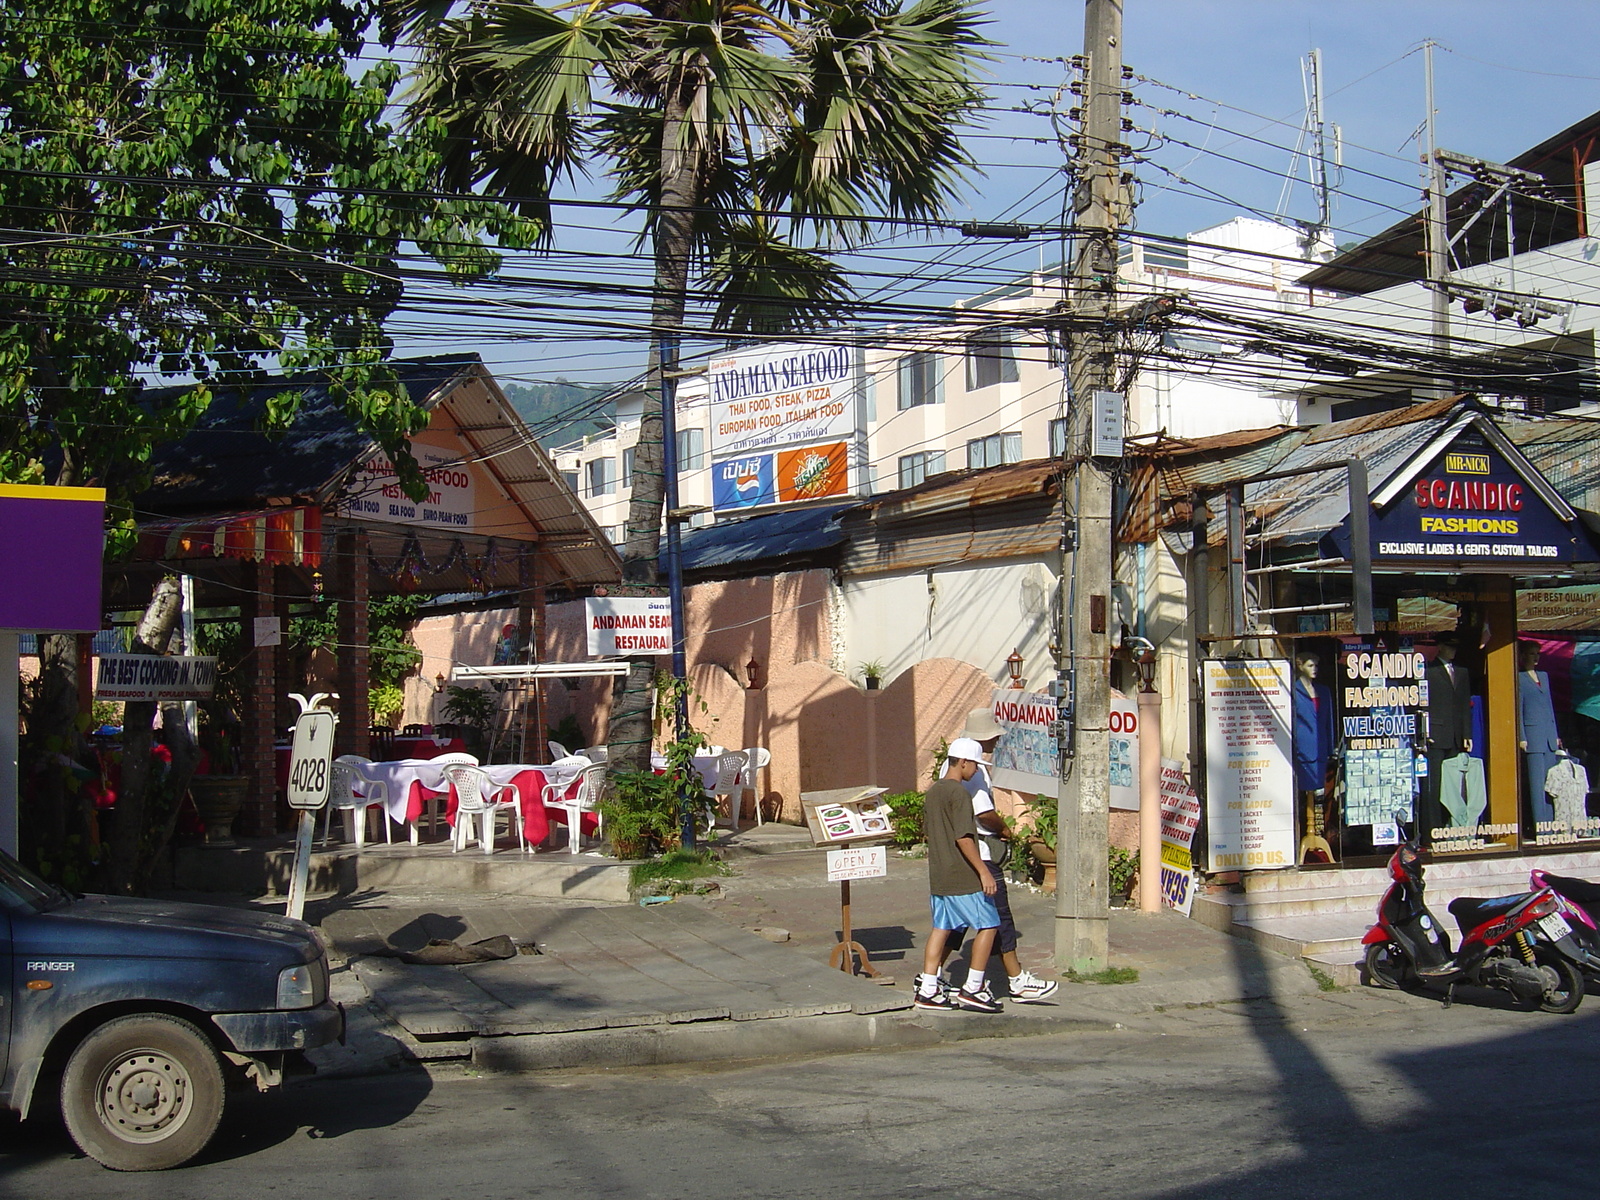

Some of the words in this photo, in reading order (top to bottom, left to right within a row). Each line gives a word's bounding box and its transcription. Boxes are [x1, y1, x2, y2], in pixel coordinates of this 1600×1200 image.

[713, 361, 779, 403] ANDAMAN
[782, 345, 849, 389] SEAFOOD
[729, 403, 746, 417] THAI
[749, 399, 772, 412] FOOD,
[775, 392, 804, 409] STEAK,
[806, 386, 831, 401] PIZZA
[719, 417, 757, 435] EUROPIAN
[759, 413, 783, 429] FOOD,
[785, 407, 817, 423] ITALIAN
[820, 402, 844, 418] FOOD
[1449, 455, 1488, 472] MR-NICK
[382, 483, 442, 505] RESTAANT
[1414, 479, 1524, 512] SCANDIC
[364, 500, 380, 513] FOOD
[388, 504, 400, 516] SEA
[400, 506, 416, 518] FOOD
[453, 513, 468, 525] FOOD
[1420, 516, 1520, 535] FASHIONS
[1379, 542, 1425, 555] EXCLUSIVE
[1426, 543, 1454, 556] LADIES
[1456, 544, 1463, 555] &
[1464, 543, 1491, 556] GENTS
[1492, 544, 1525, 556] CUSTOM
[1526, 545, 1558, 557] TAILORS
[1527, 592, 1542, 602] THE
[1544, 592, 1562, 602] BEST
[1564, 592, 1597, 603] QUALITY
[1527, 606, 1542, 616] WITH
[593, 615, 647, 630] ANDAMAN
[100, 658, 117, 685] THE
[117, 658, 140, 685] BEST
[140, 659, 179, 686] COOKING
[179, 661, 191, 685] IN
[192, 660, 217, 685] TOWN
[1346, 652, 1425, 679] SCANDIC
[1216, 679, 1246, 688] MASTER
[97, 689, 116, 698] FRESH
[117, 690, 146, 698] SEAFOOD
[158, 690, 185, 698] POPULAR
[1345, 685, 1419, 708] FASHIONS
[994, 700, 1056, 727] ANDAMAN
[1343, 714, 1416, 737] WELCOME
[1350, 738, 1366, 750] OPEN
[1366, 738, 1372, 749] 9
[1227, 761, 1243, 769] FOR
[1244, 760, 1270, 768] GENTS
[291, 758, 326, 793] 4028
[1227, 801, 1243, 809] FOR
[1245, 800, 1273, 809] LADIES
[1431, 825, 1477, 840] GIORGIO
[1478, 822, 1518, 836] ARMANI
[1536, 820, 1567, 833] HUGO
[1431, 838, 1485, 853] VERSACE
[1536, 833, 1579, 846] ESCADA
[834, 855, 865, 869] OPEN
[1215, 852, 1245, 867] ONLY
[1247, 851, 1264, 866] 99
[27, 961, 75, 972] RANGER
